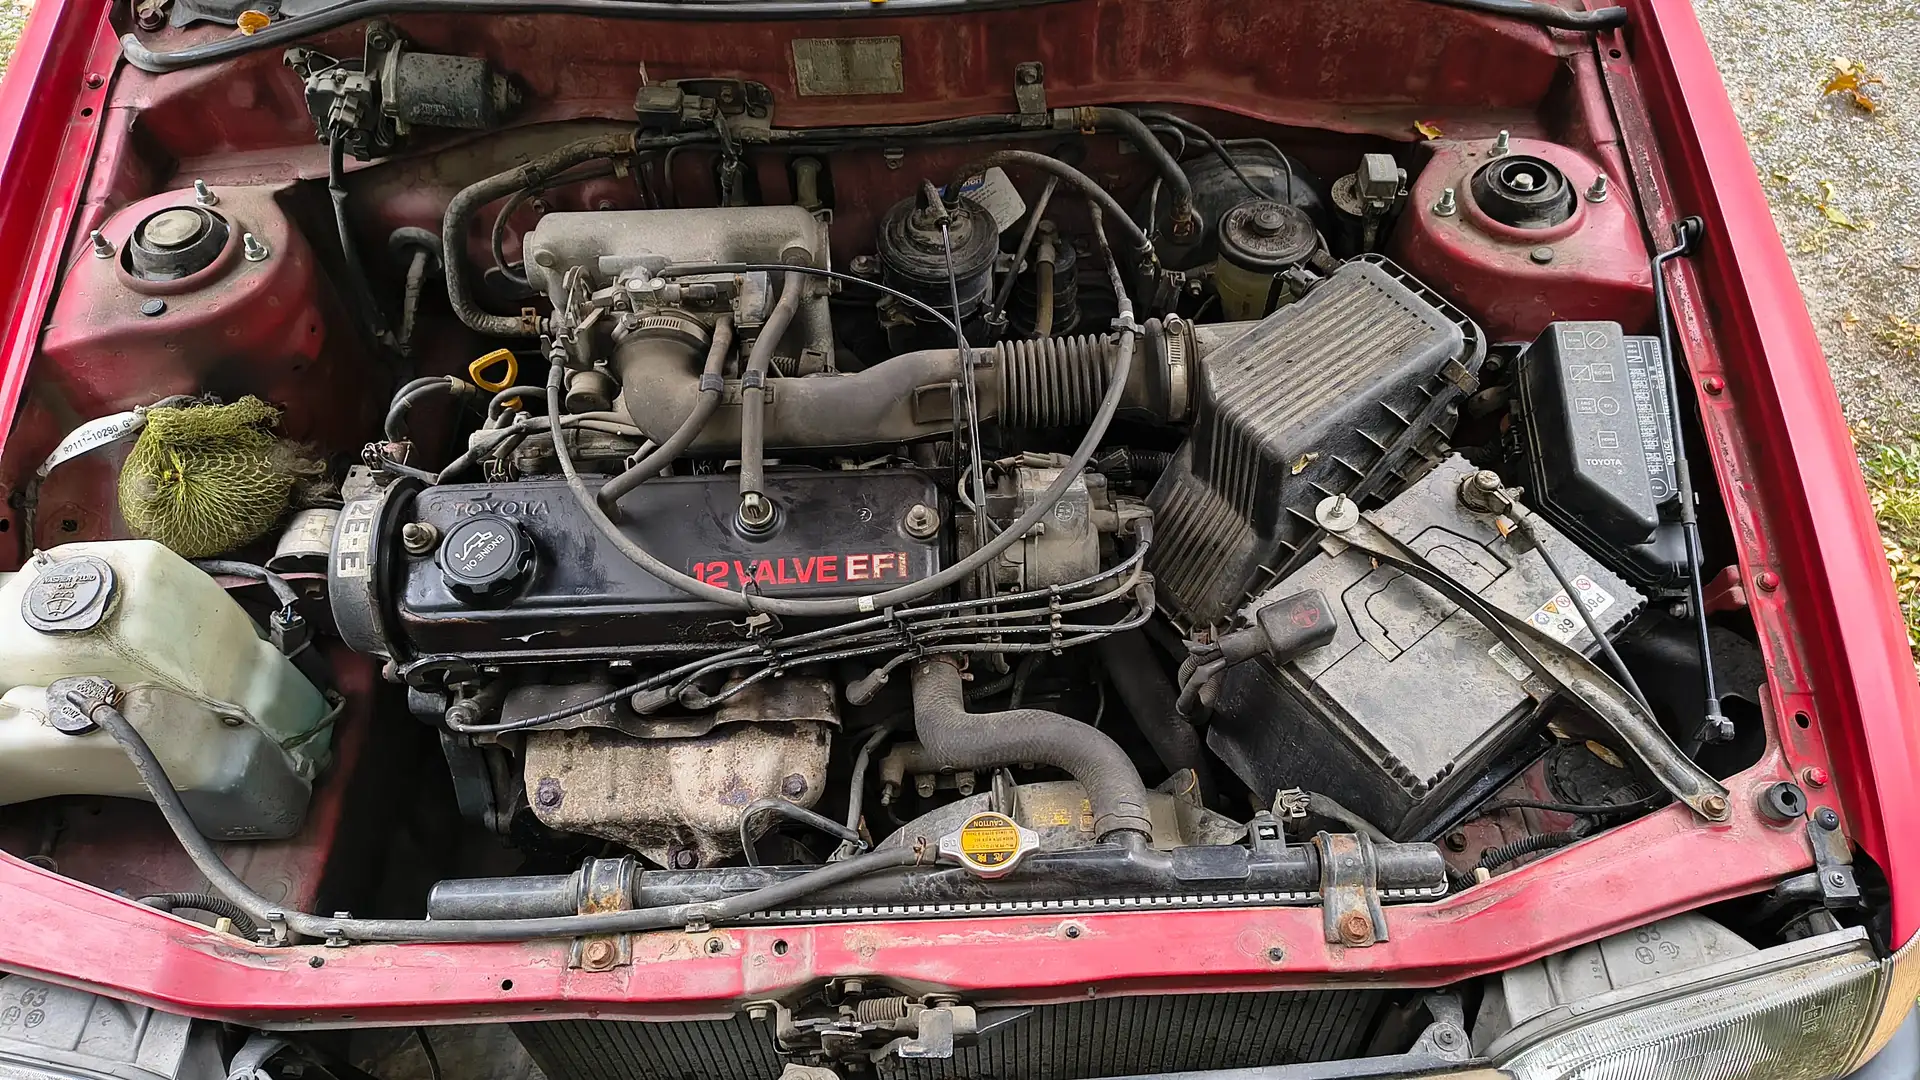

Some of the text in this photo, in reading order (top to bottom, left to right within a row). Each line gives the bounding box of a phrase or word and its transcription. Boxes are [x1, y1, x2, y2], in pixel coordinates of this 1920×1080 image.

[1585, 459, 1623, 467] TOYOTA
[453, 500, 551, 518] TOYOTA
[461, 534, 506, 573] ENGINE OIL
[692, 560, 730, 589] 12
[733, 554, 838, 587] VALVE
[973, 819, 1004, 828] CAUTION
